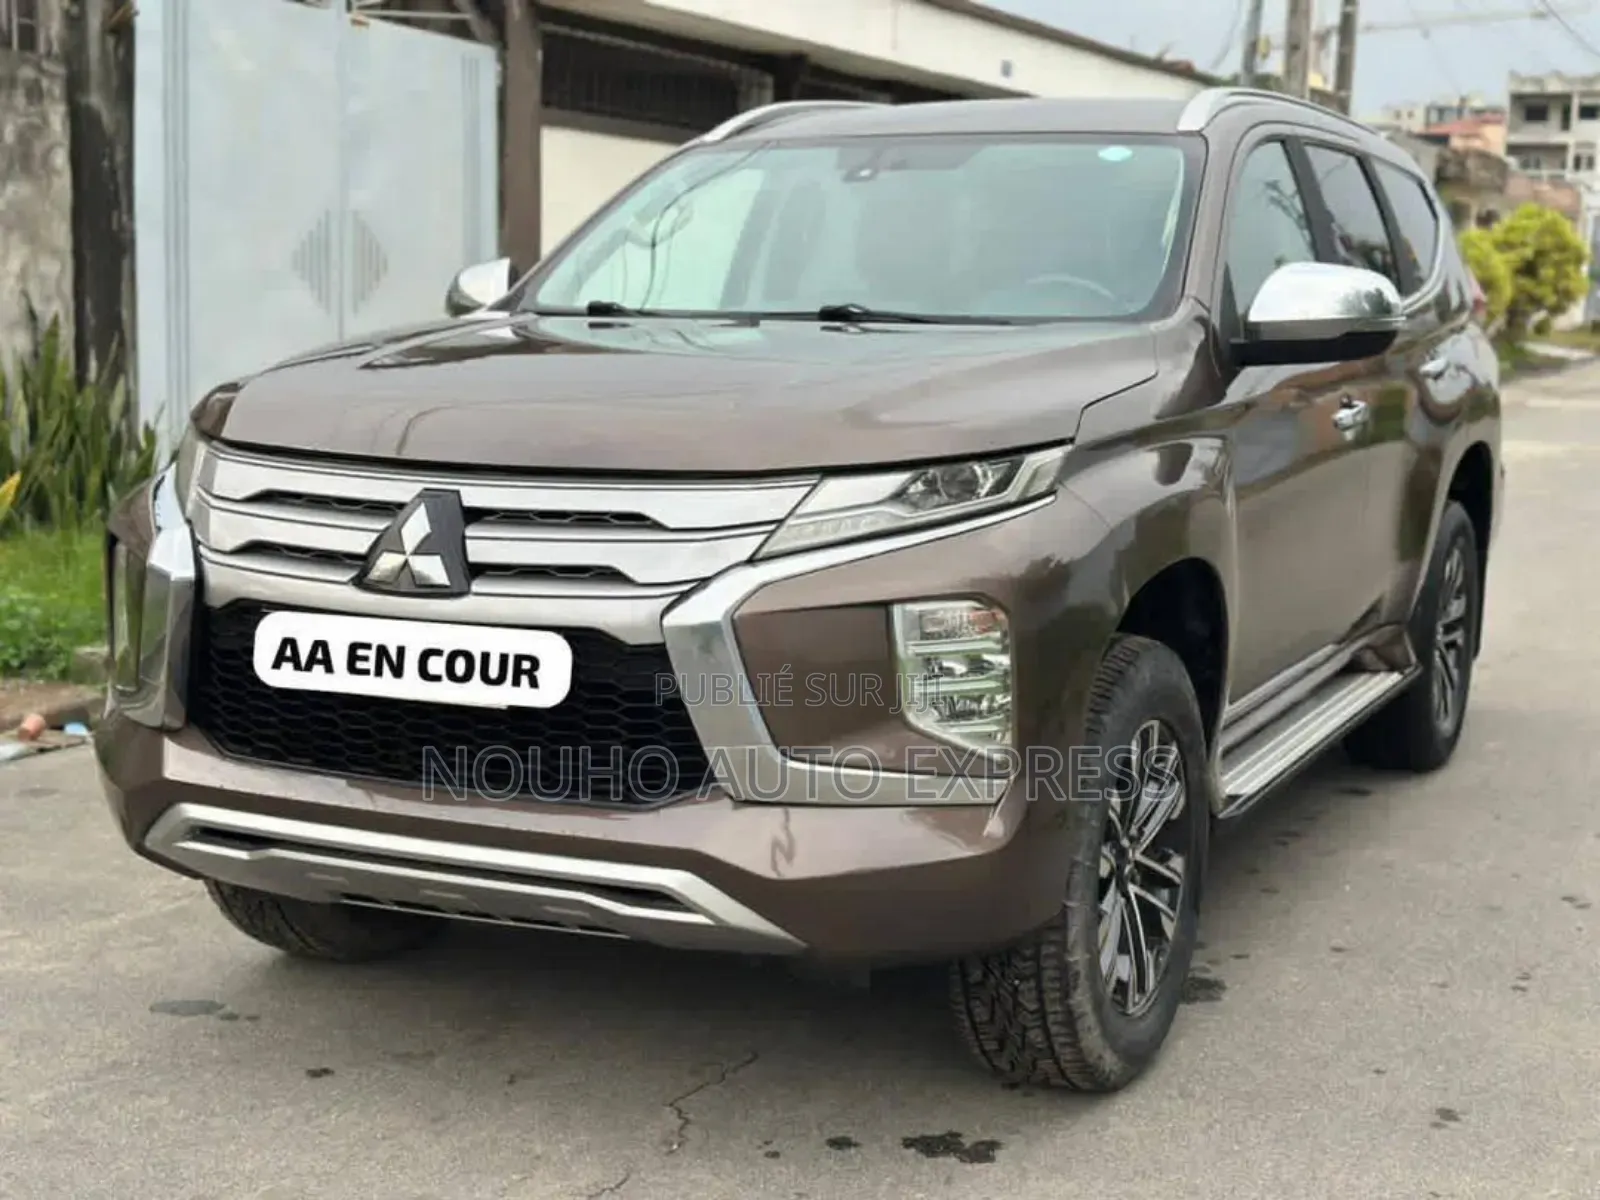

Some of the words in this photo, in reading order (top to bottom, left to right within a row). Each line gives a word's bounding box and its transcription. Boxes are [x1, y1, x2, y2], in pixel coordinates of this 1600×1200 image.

[271, 636, 334, 674] AA
[346, 641, 406, 679] EN
[417, 647, 541, 689] COUR
